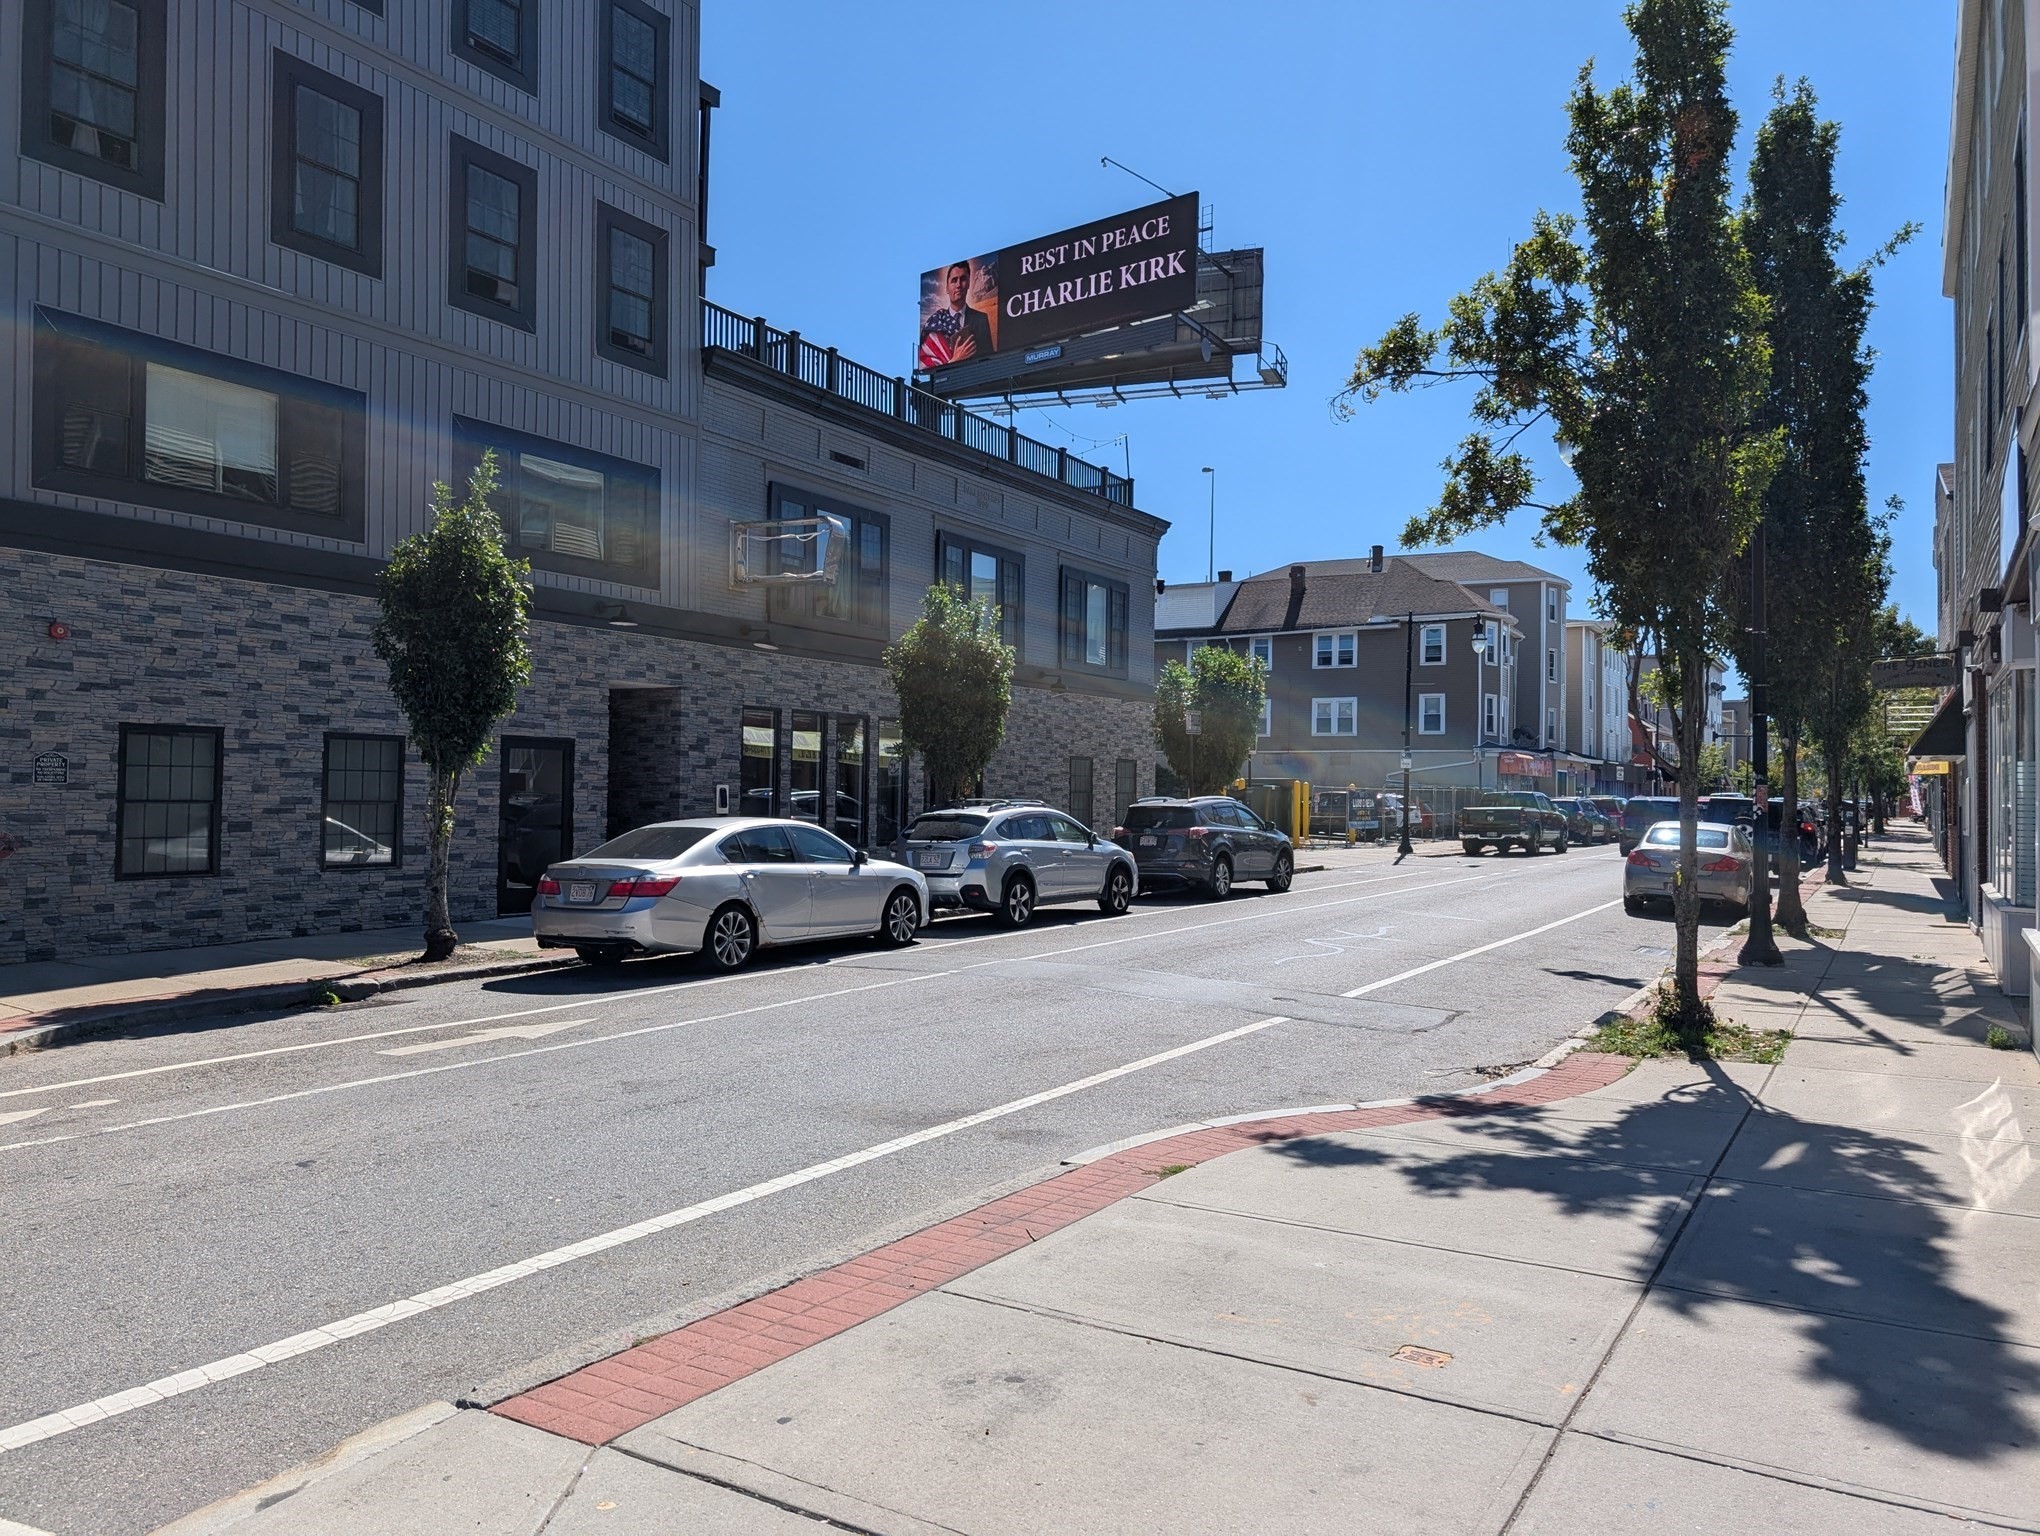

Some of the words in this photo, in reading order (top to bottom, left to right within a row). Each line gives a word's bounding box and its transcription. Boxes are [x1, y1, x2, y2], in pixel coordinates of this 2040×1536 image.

[1020, 244, 1069, 276] REST
[1072, 236, 1098, 261] IN
[1101, 215, 1171, 253] PEACE
[1006, 269, 1114, 318] CHARLIE
[1119, 249, 1187, 290] KIRK
[1026, 348, 1060, 362] MURRAY
[1876, 662, 1898, 670] THE
